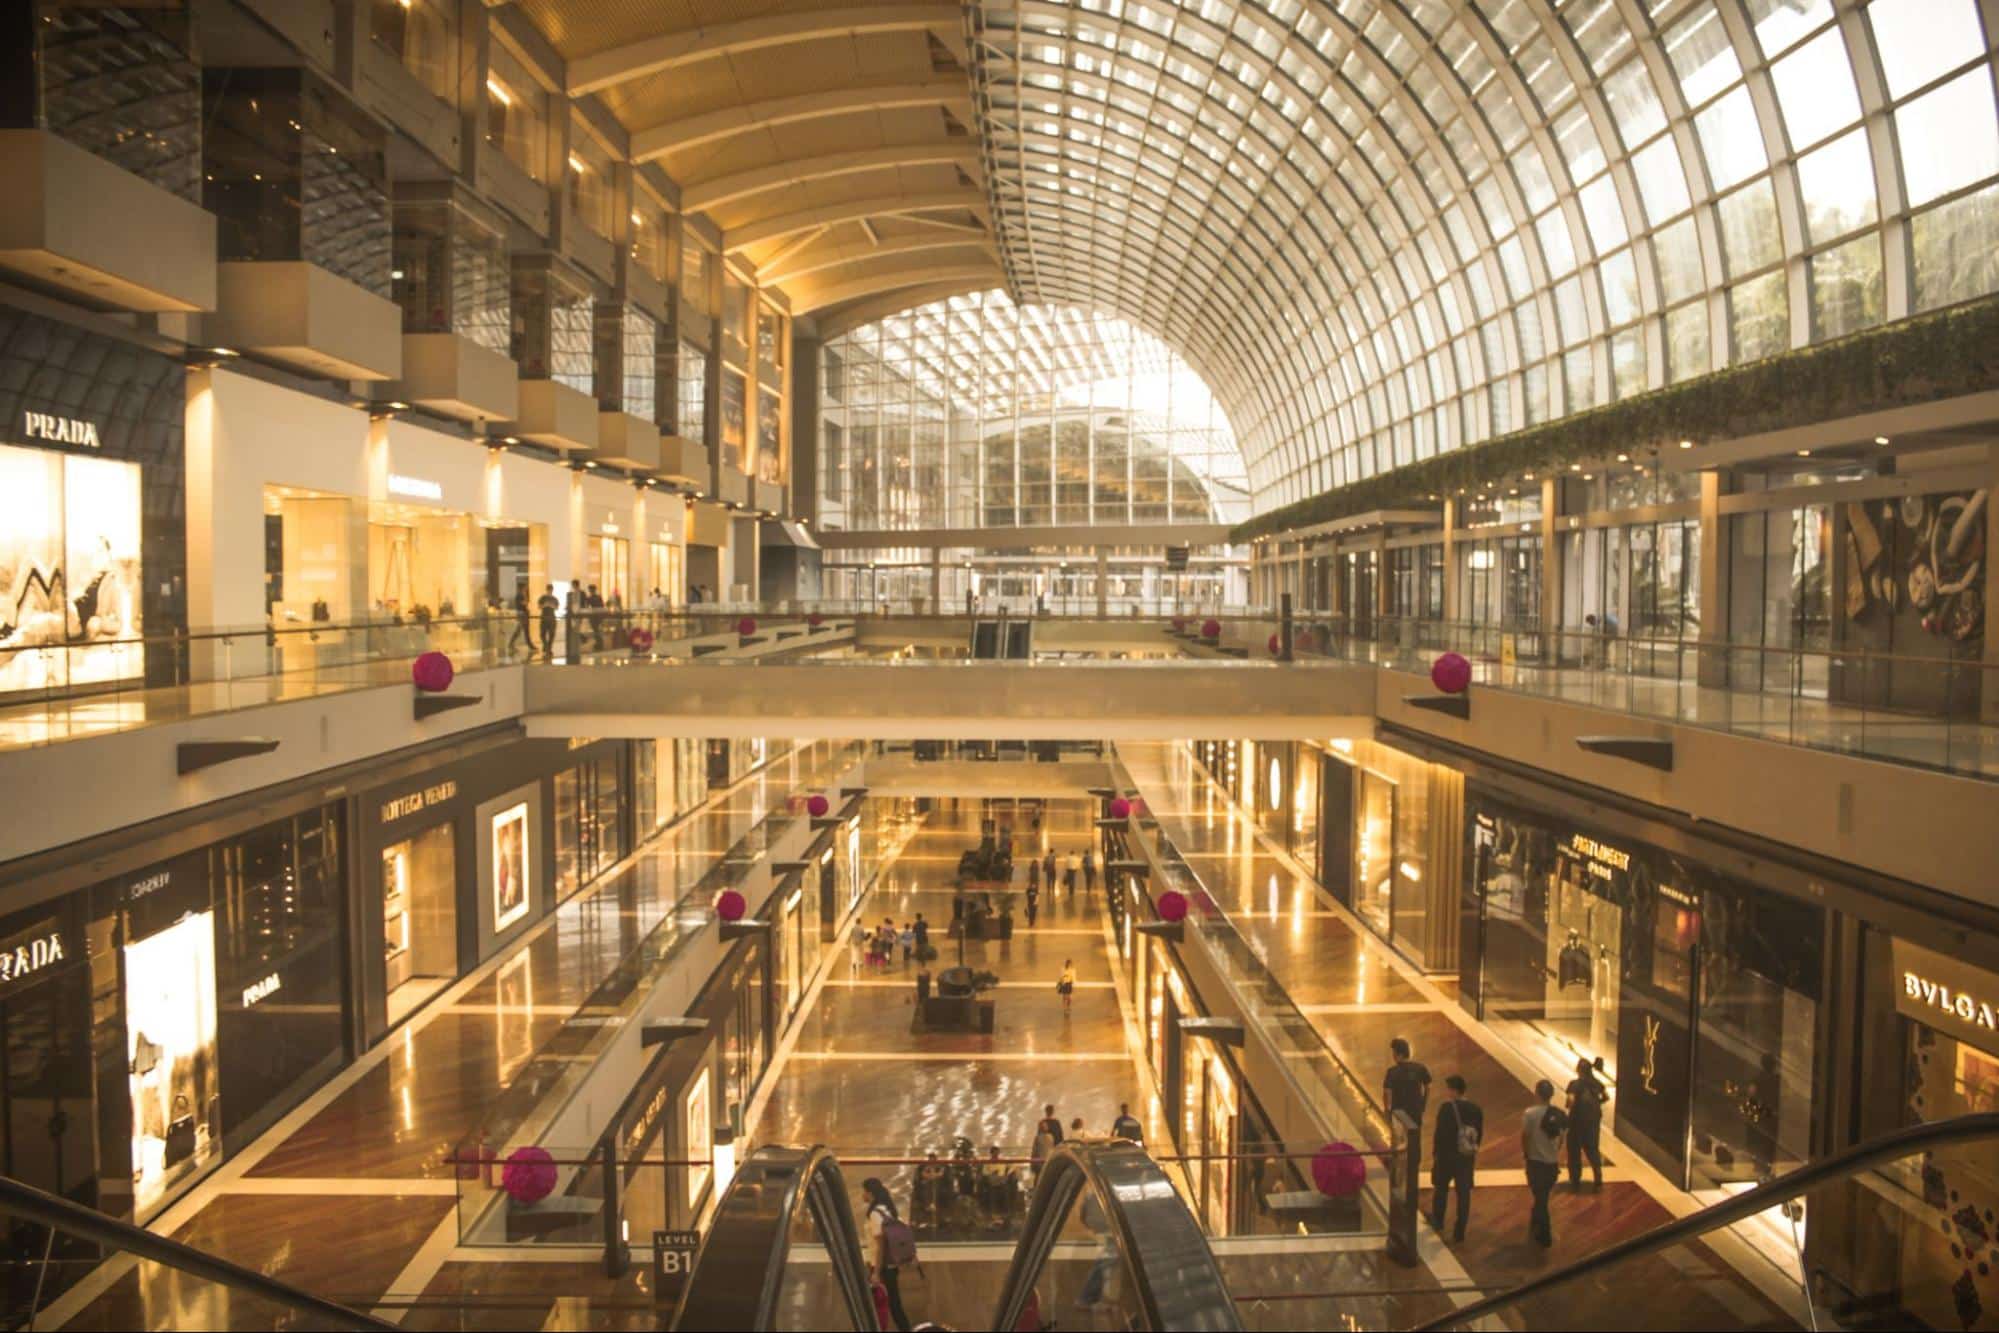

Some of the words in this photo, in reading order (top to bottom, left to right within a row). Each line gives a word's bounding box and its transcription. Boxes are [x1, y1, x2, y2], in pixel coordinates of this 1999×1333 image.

[25, 410, 100, 448] PRADA
[1903, 970, 1999, 1031] BVLGA
[658, 1234, 696, 1245] LEVEL
[663, 1250, 691, 1274] B1
